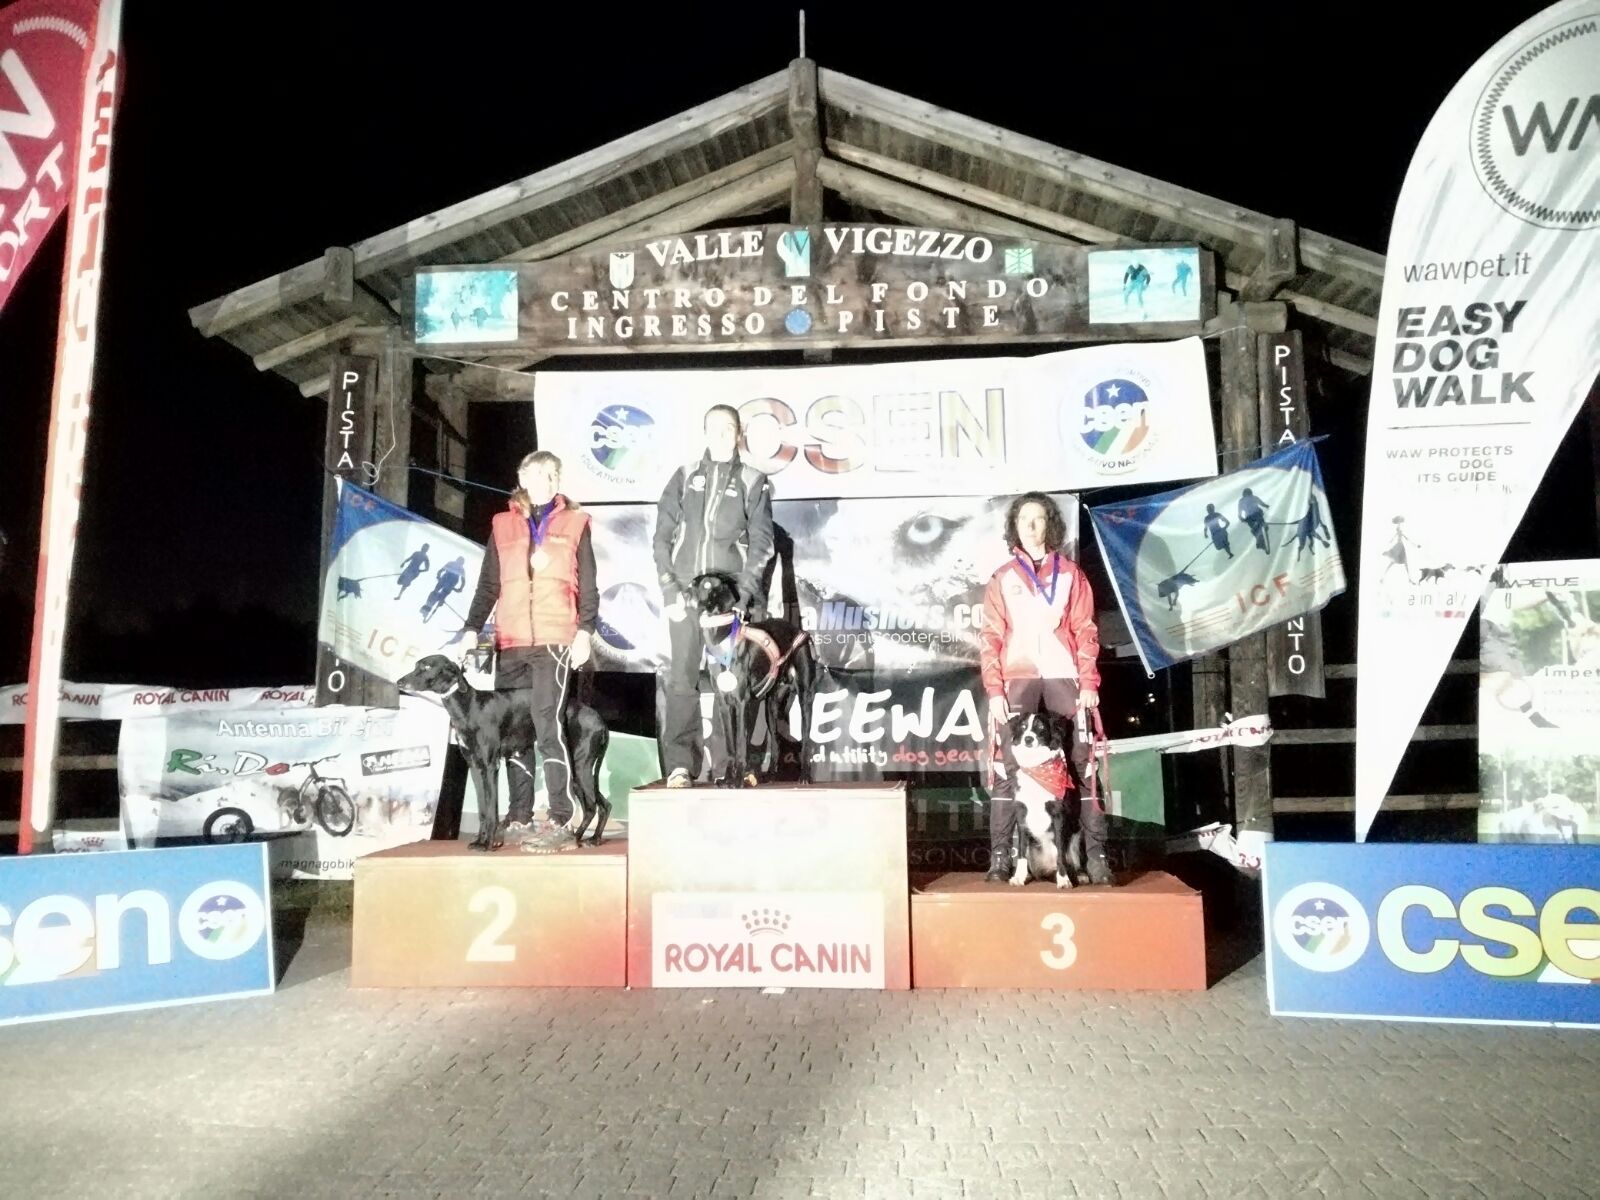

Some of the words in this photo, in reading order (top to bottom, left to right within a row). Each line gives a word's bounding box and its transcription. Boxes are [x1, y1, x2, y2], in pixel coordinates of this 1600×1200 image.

[646, 230, 765, 267] VALLE
[824, 227, 993, 263] VIGEZZO
[1403, 251, 1532, 284] wawpet.it
[551, 287, 726, 311] CENTRO
[754, 285, 844, 306] DEL
[871, 278, 1049, 303] FONDO
[567, 313, 765, 339] INGRESSO
[838, 305, 1000, 333] PISTE
[1396, 300, 1528, 338] EASY
[1392, 337, 1500, 374] DOG
[1275, 345, 1297, 444] PISTA
[1393, 371, 1536, 409] WALK
[337, 371, 359, 469] PISTA
[737, 388, 1007, 476] CSEN
[1386, 448, 1424, 460] WAW
[1428, 445, 1514, 459] PROTECTS
[1459, 458, 1495, 470] DOG
[1417, 473, 1441, 483] ITS
[1447, 470, 1497, 482] GUIDE
[1234, 573, 1293, 613] ICF
[836, 631, 867, 644] and
[133, 692, 177, 705] ROYAL
[180, 689, 230, 703] CANIN
[216, 719, 312, 738] Antenna
[892, 749, 930, 766] dog
[465, 886, 517, 962] 2
[1289, 914, 1352, 937] csen
[665, 942, 762, 973] ROYAL
[770, 941, 872, 974] CANIN
[1040, 912, 1078, 970] 3
